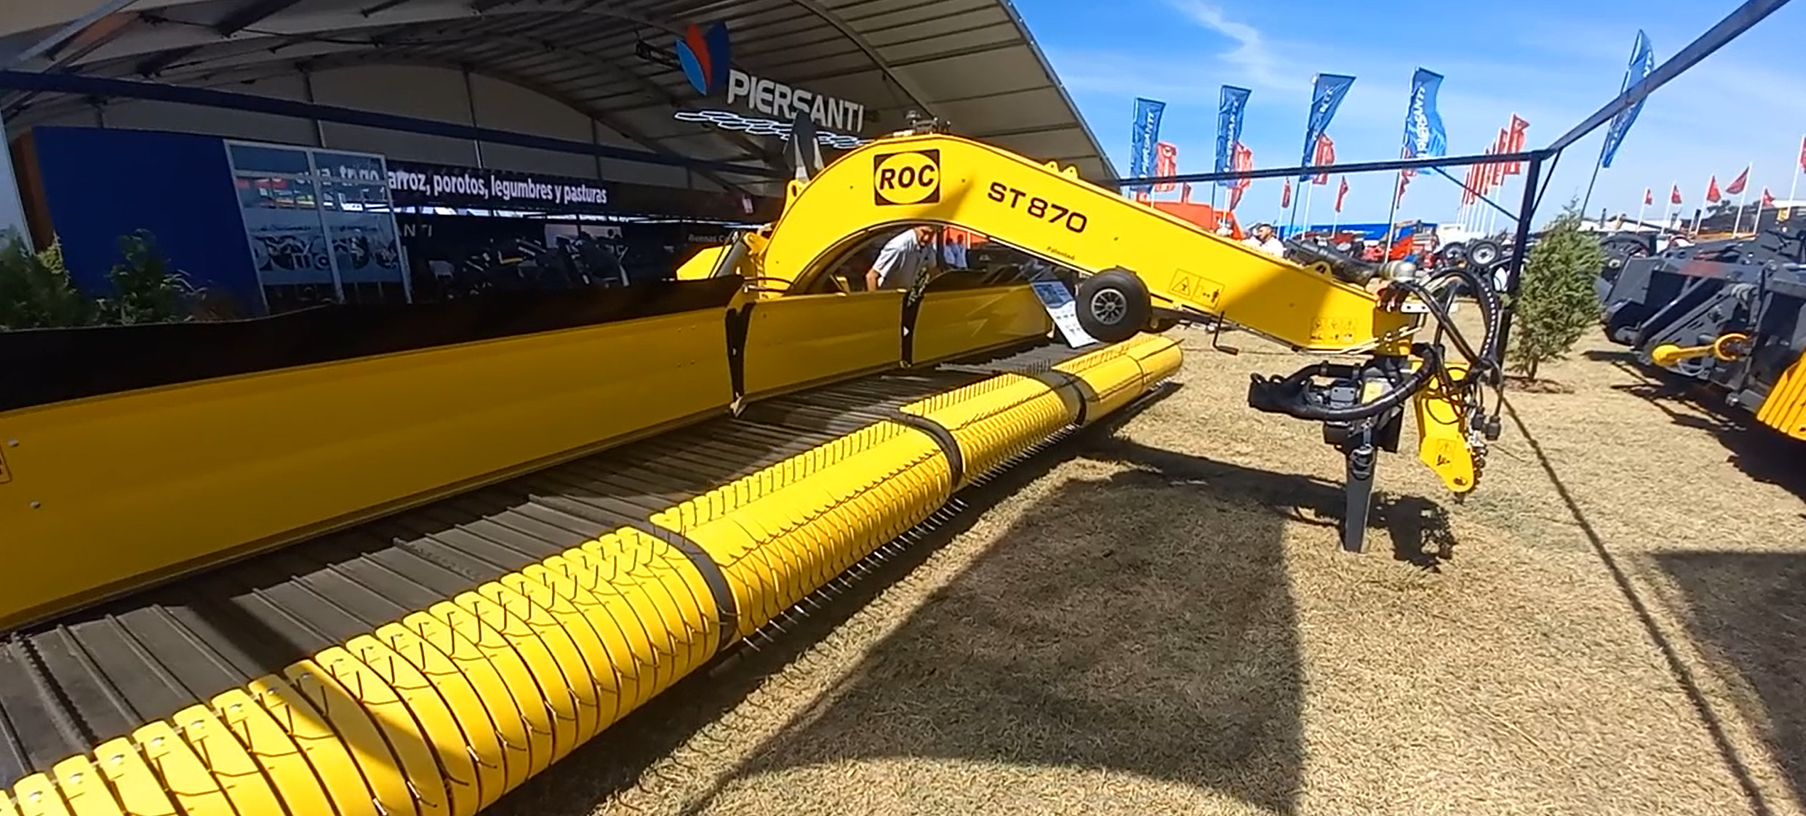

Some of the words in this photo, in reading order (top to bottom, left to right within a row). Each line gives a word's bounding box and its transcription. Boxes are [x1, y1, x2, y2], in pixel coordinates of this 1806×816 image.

[727, 69, 864, 133] PIERSANTI
[388, 170, 430, 195] arroz,
[433, 174, 489, 199] porotos,
[491, 175, 553, 201] legumbres
[554, 184, 562, 201] y
[564, 183, 608, 204] pasturas
[880, 165, 935, 190] ROC
[1046, 246, 1076, 261] Patented
